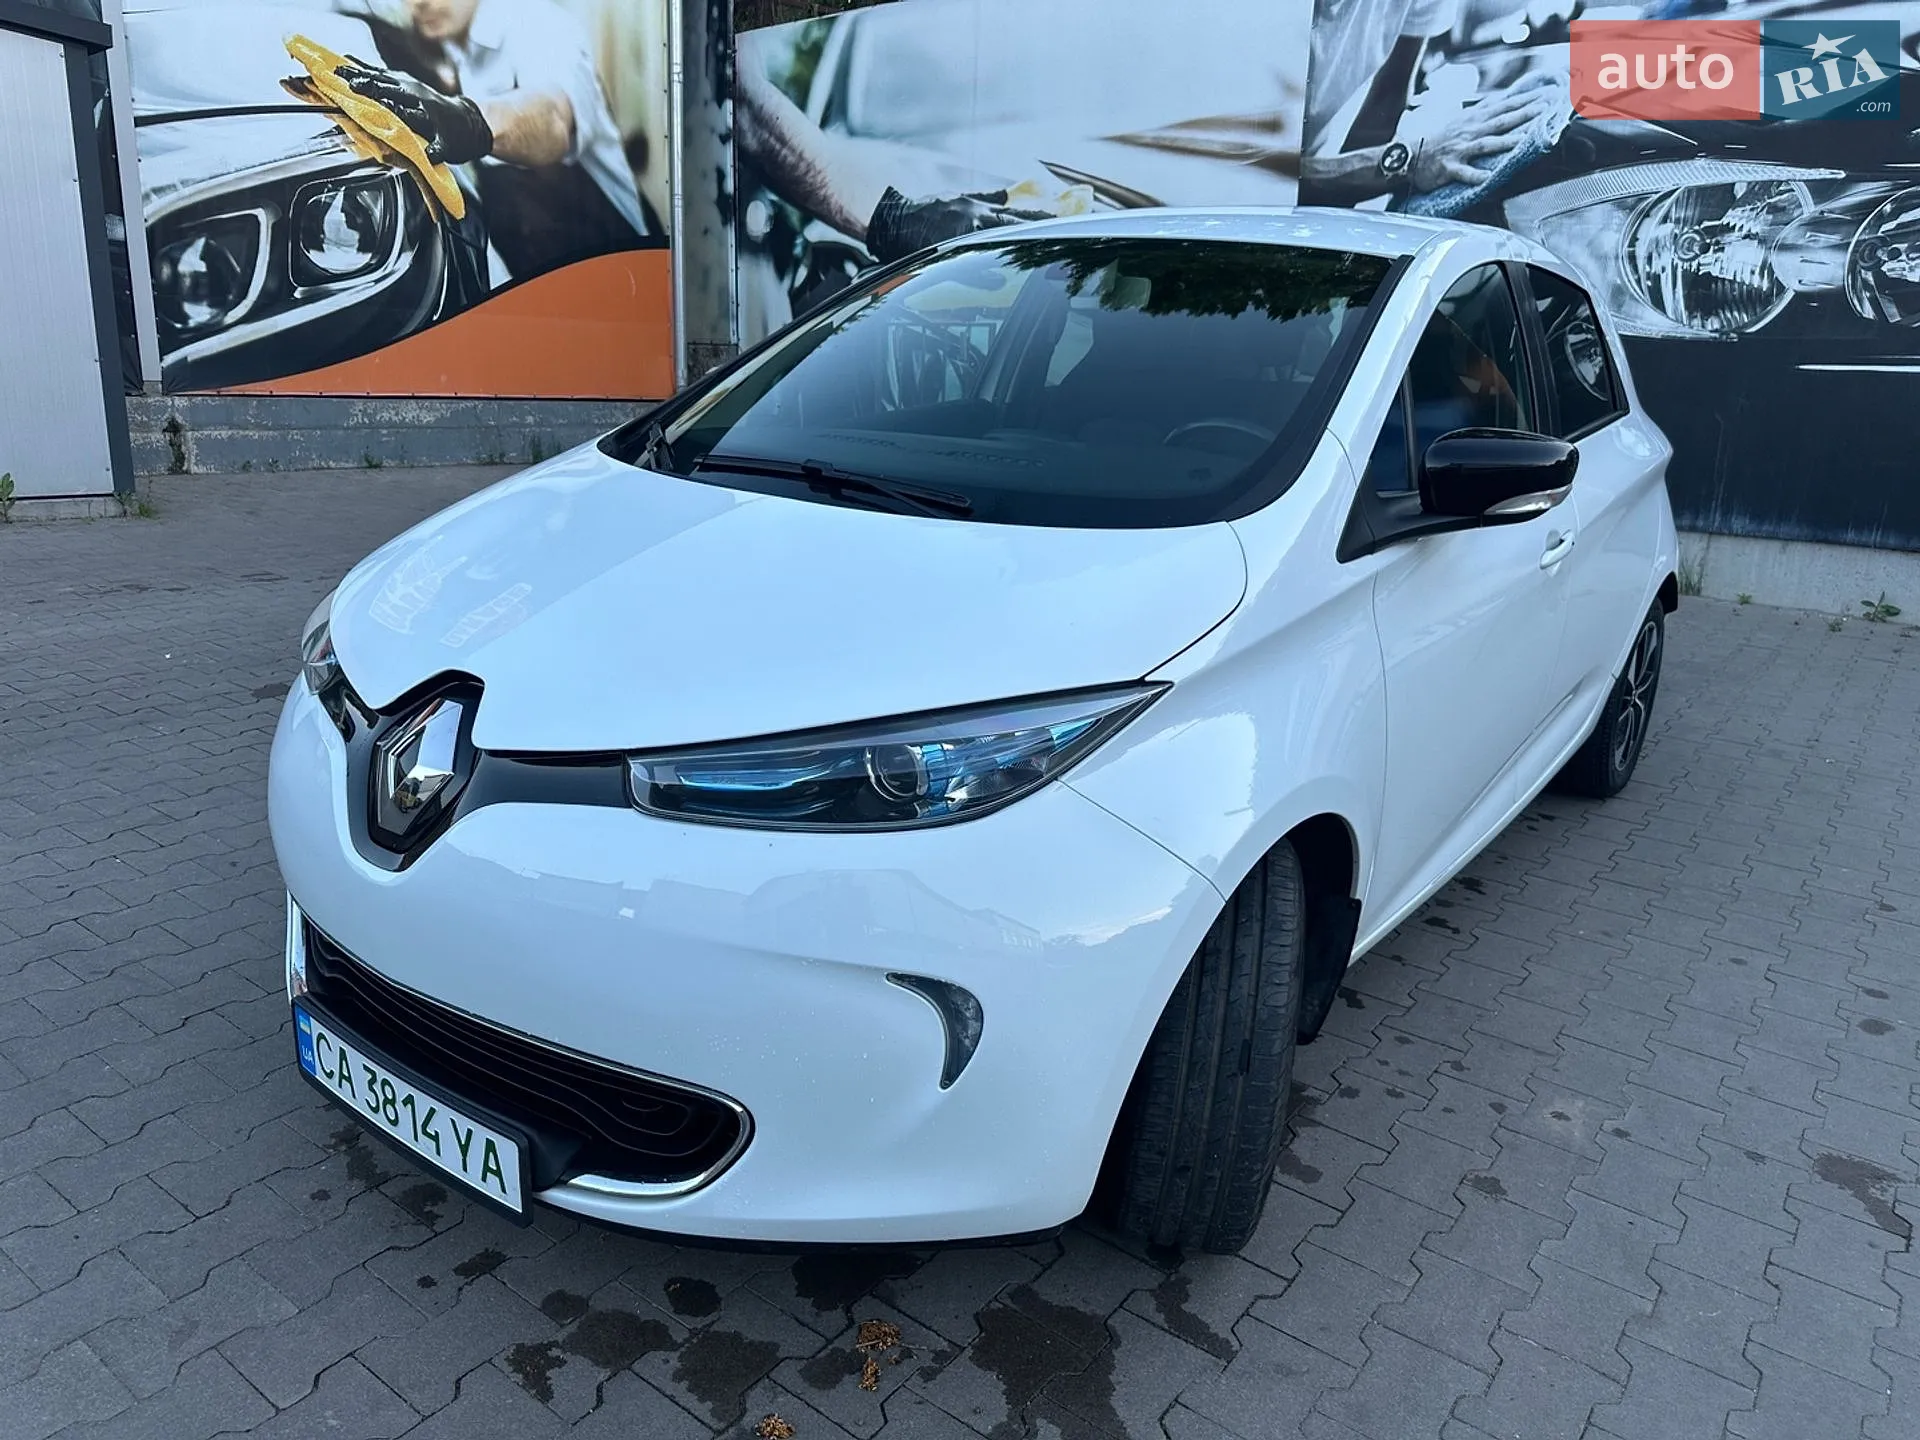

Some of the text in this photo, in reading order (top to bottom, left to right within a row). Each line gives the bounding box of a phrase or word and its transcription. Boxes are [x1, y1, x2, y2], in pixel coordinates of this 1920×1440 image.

[301, 1045, 315, 1065] UA
[316, 1031, 507, 1195] CA 3814 YA
